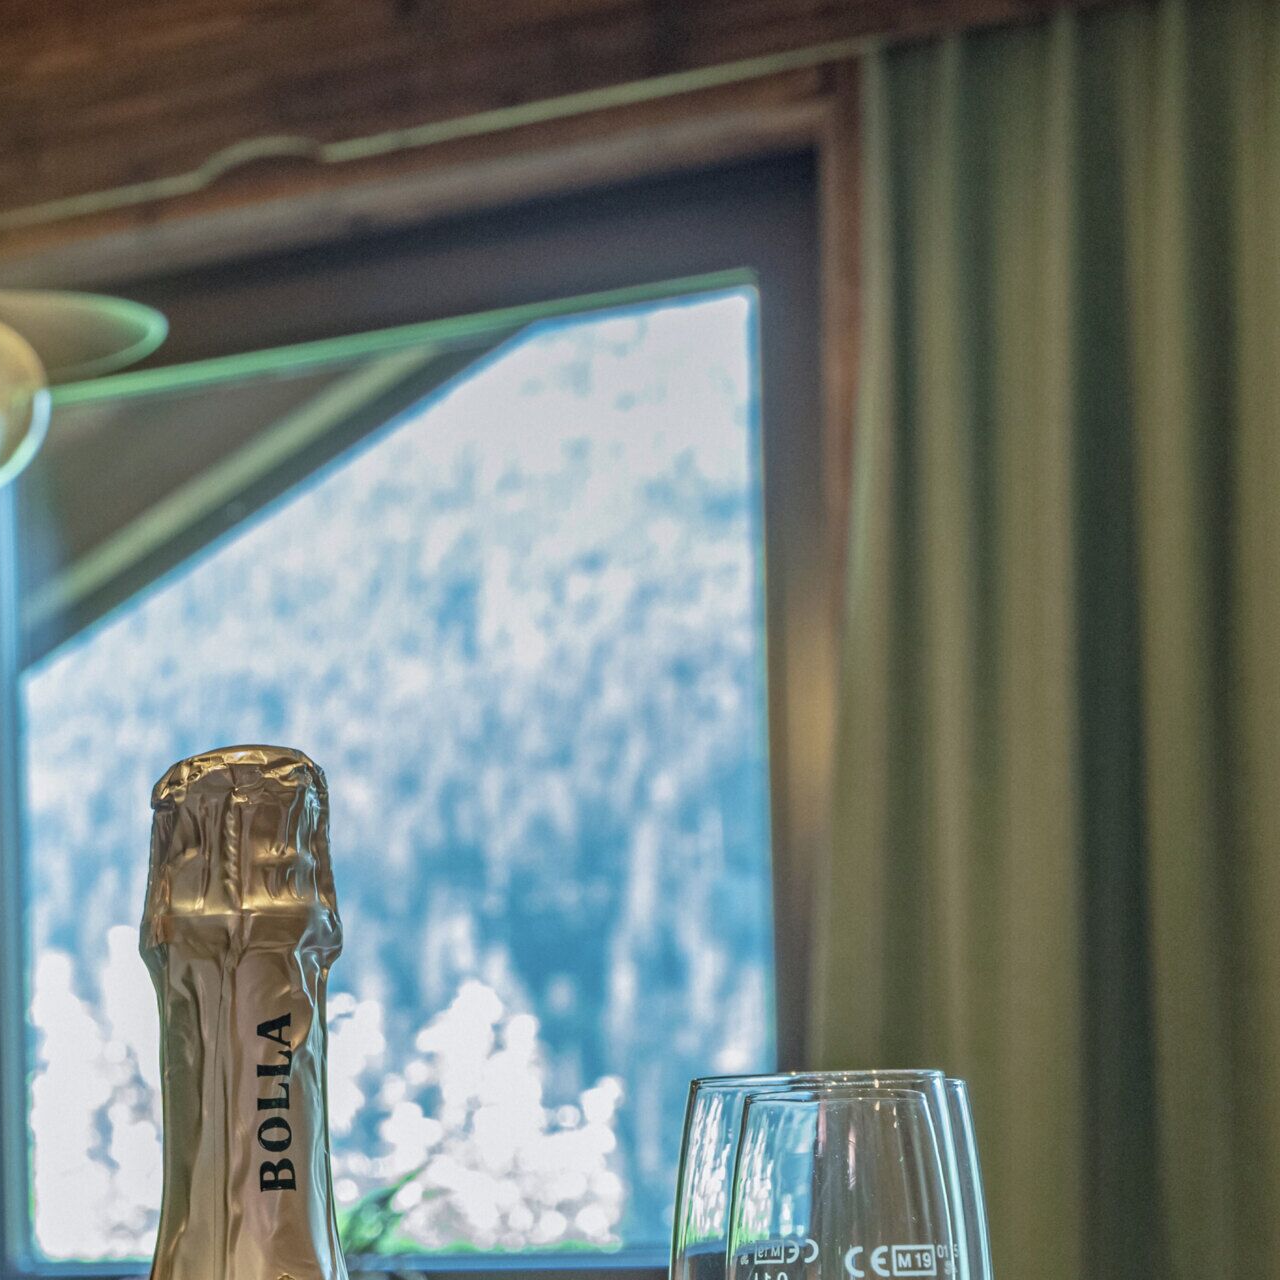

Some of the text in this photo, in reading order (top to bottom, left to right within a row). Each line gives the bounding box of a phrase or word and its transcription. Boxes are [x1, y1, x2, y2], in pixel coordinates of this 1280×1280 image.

[256, 1012, 297, 1193] BOLLA
[898, 1253, 912, 1268] M
[915, 1252, 932, 1268] 19
